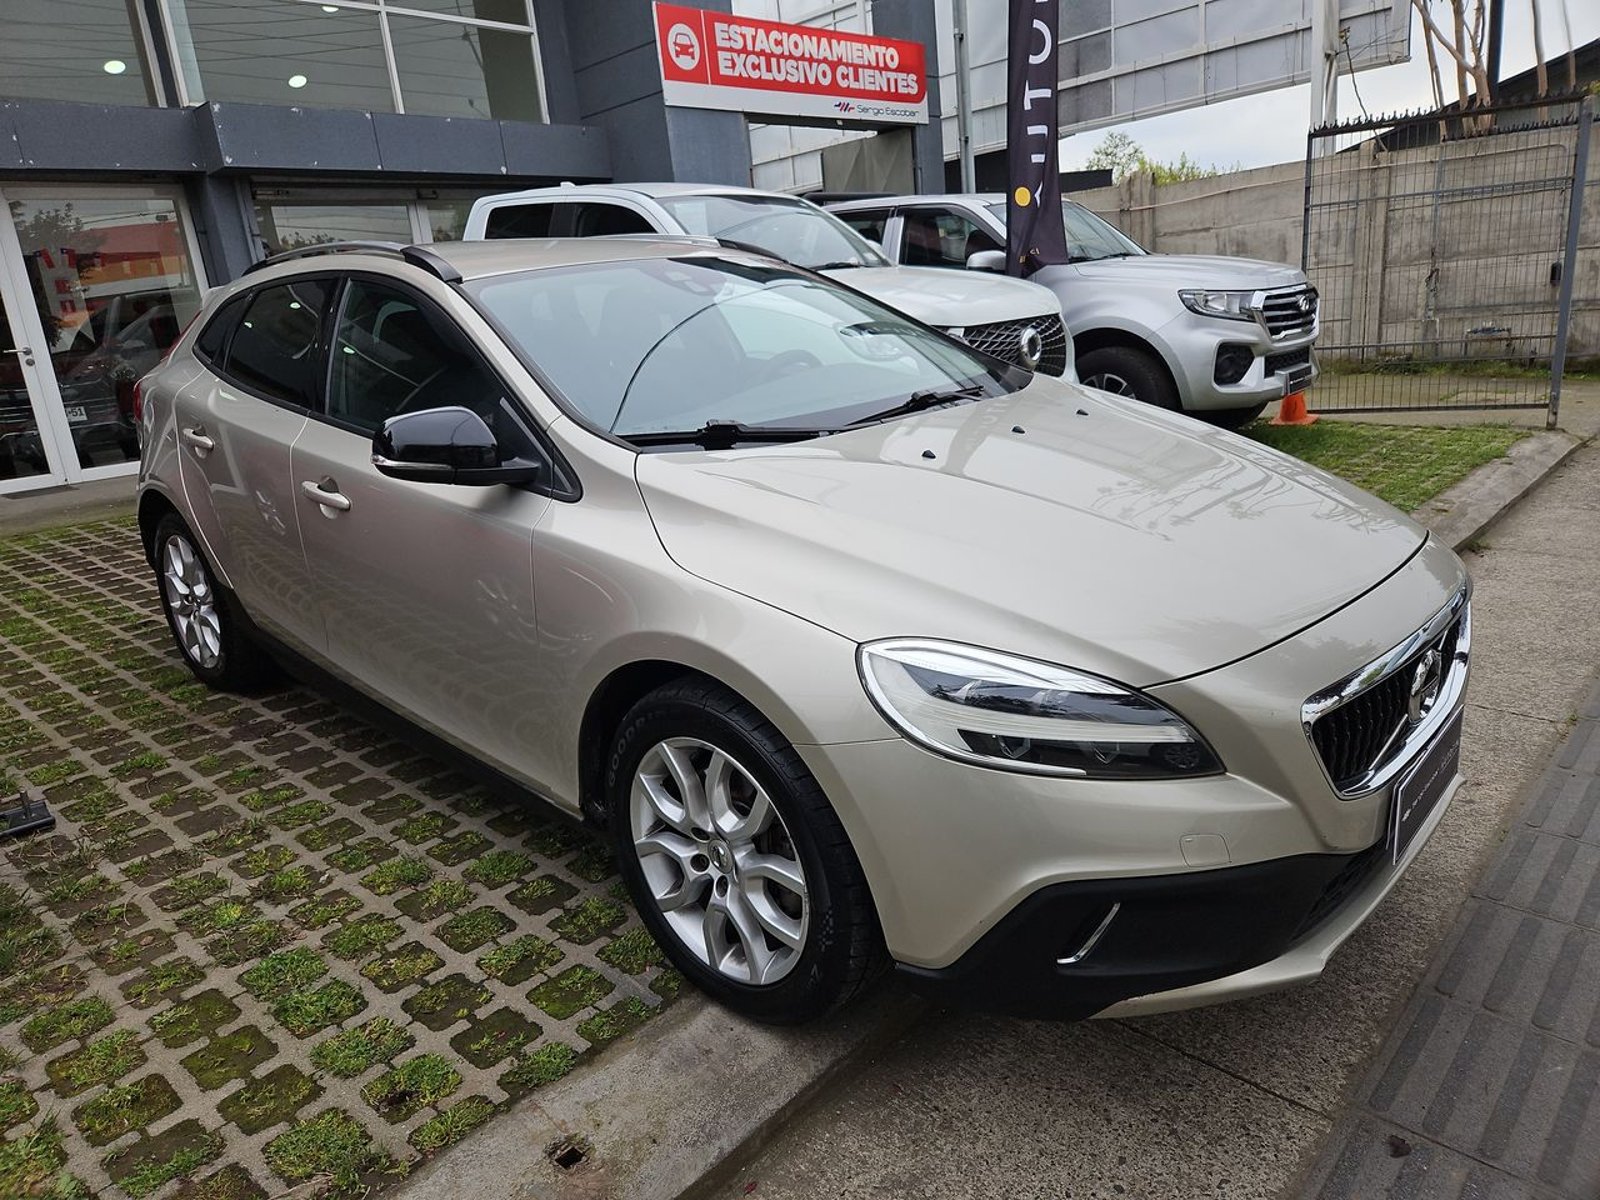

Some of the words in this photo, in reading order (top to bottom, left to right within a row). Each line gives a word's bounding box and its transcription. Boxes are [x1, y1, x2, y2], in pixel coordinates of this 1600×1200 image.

[714, 22, 898, 69] ESTACIONAMIENTO
[718, 51, 831, 86] EXCLUSIVO
[836, 65, 919, 95] CLIENTES
[856, 104, 884, 116] Sergio
[885, 107, 919, 117] Escobar
